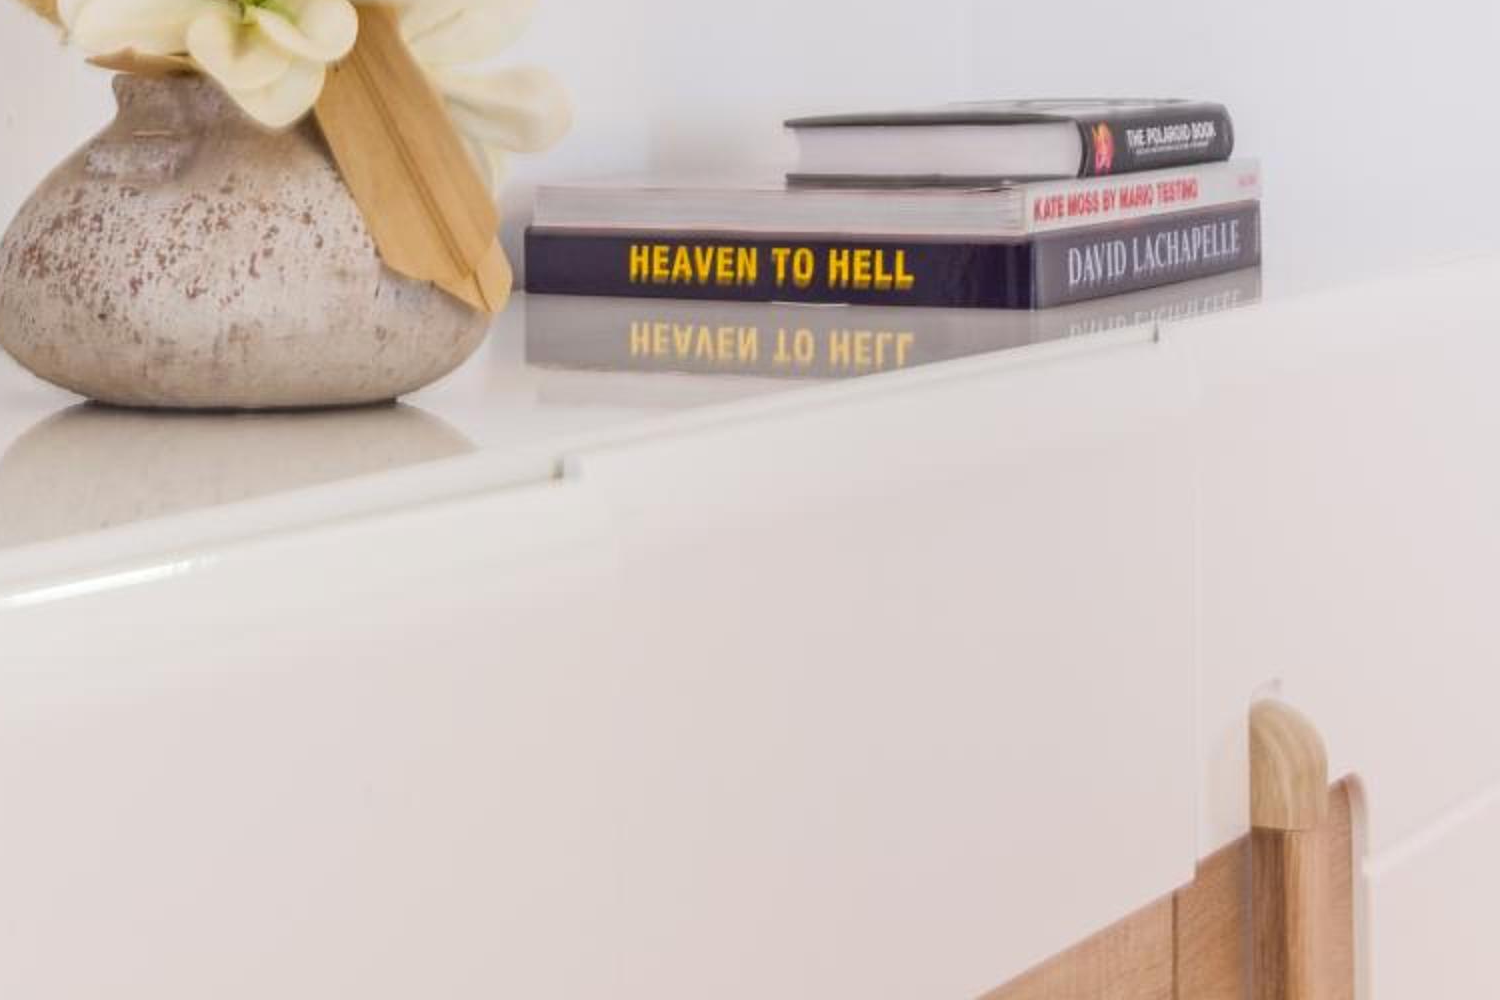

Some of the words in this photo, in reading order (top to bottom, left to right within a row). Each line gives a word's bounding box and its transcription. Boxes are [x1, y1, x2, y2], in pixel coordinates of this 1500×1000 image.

[1126, 128, 1145, 147] THE
[1146, 123, 1191, 145] POLAROID
[1191, 121, 1217, 140] BOOK
[1034, 195, 1064, 221] KATE
[1068, 190, 1099, 216] MOSS
[1103, 186, 1116, 211] BY
[1119, 183, 1153, 208] MARIO
[1156, 178, 1198, 204] TESTINO
[629, 245, 758, 283] HEAVEN
[771, 247, 815, 286] TO
[828, 249, 915, 290] HELL
[1068, 240, 1127, 284] DAVID
[1132, 219, 1240, 272] LACHAPELLE
